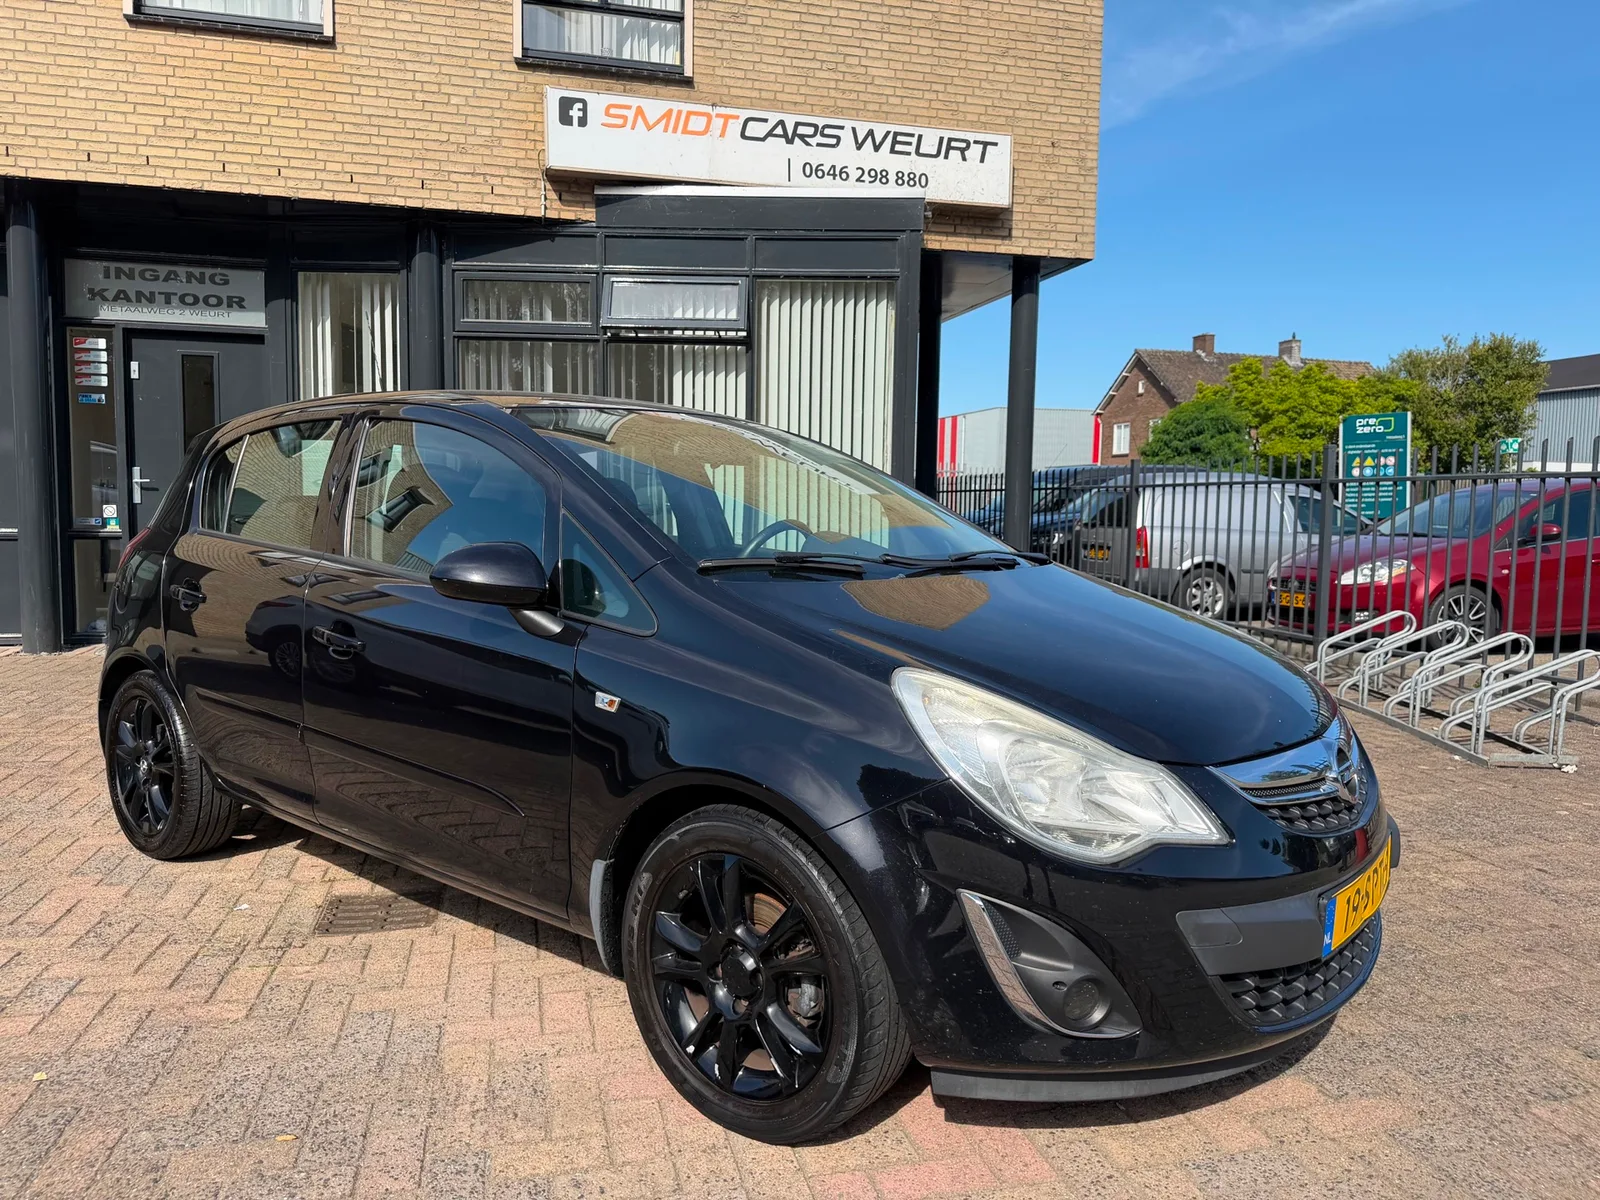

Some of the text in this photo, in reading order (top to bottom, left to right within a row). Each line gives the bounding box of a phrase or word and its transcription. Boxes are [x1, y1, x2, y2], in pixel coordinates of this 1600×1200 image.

[851, 127, 999, 164] WEURT
[802, 163, 929, 189] 0646 298 880
[103, 265, 230, 286] INGANG
[87, 287, 247, 309] KANTOOR
[99, 304, 233, 319] METAALWEG 2 WEURT
[1355, 417, 1377, 428] pre
[1355, 425, 1385, 434] zero
[1323, 932, 1332, 946] NL
